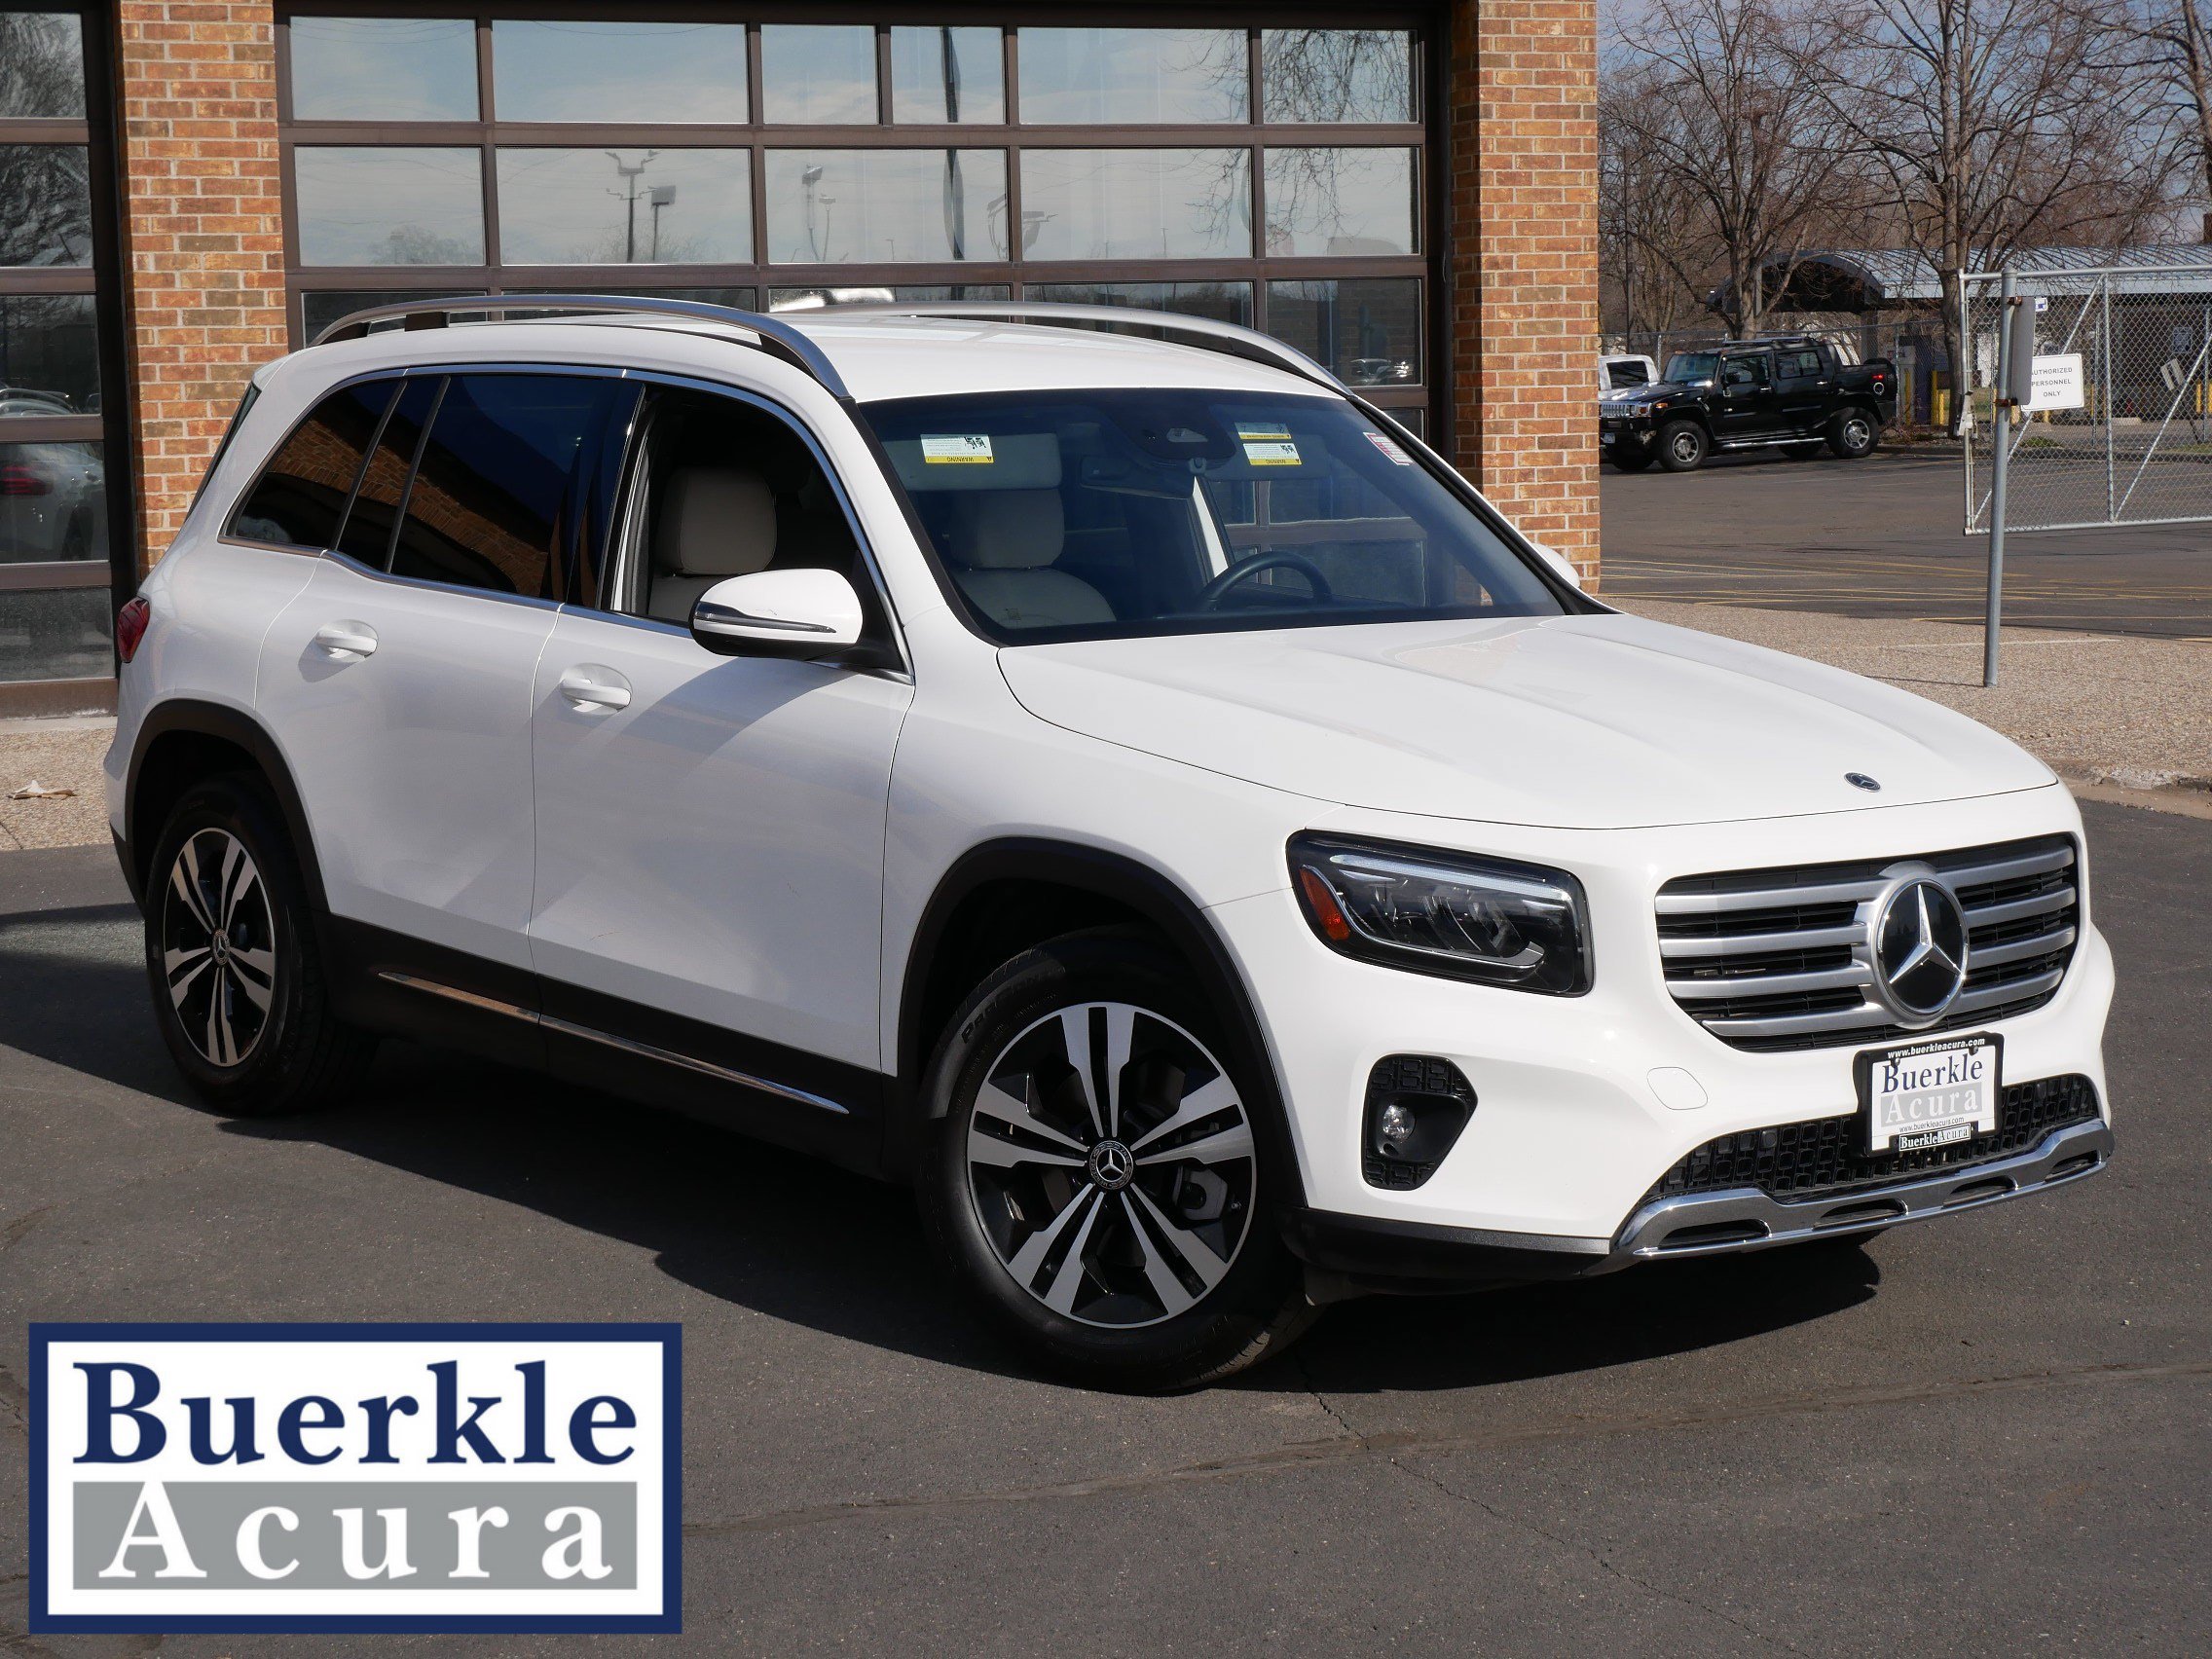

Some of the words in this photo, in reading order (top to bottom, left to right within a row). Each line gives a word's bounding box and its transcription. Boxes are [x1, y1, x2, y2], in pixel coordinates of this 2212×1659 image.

[2032, 367, 2073, 376] UTHORIZED
[2031, 378, 2072, 387] PERSONNEL
[1887, 1037, 1985, 1059] www.buerkleacura.com
[1881, 1053, 1983, 1094] Buerkle
[1885, 1088, 1978, 1124] Acura
[1899, 1116, 1965, 1133] www.buerkleacura.com
